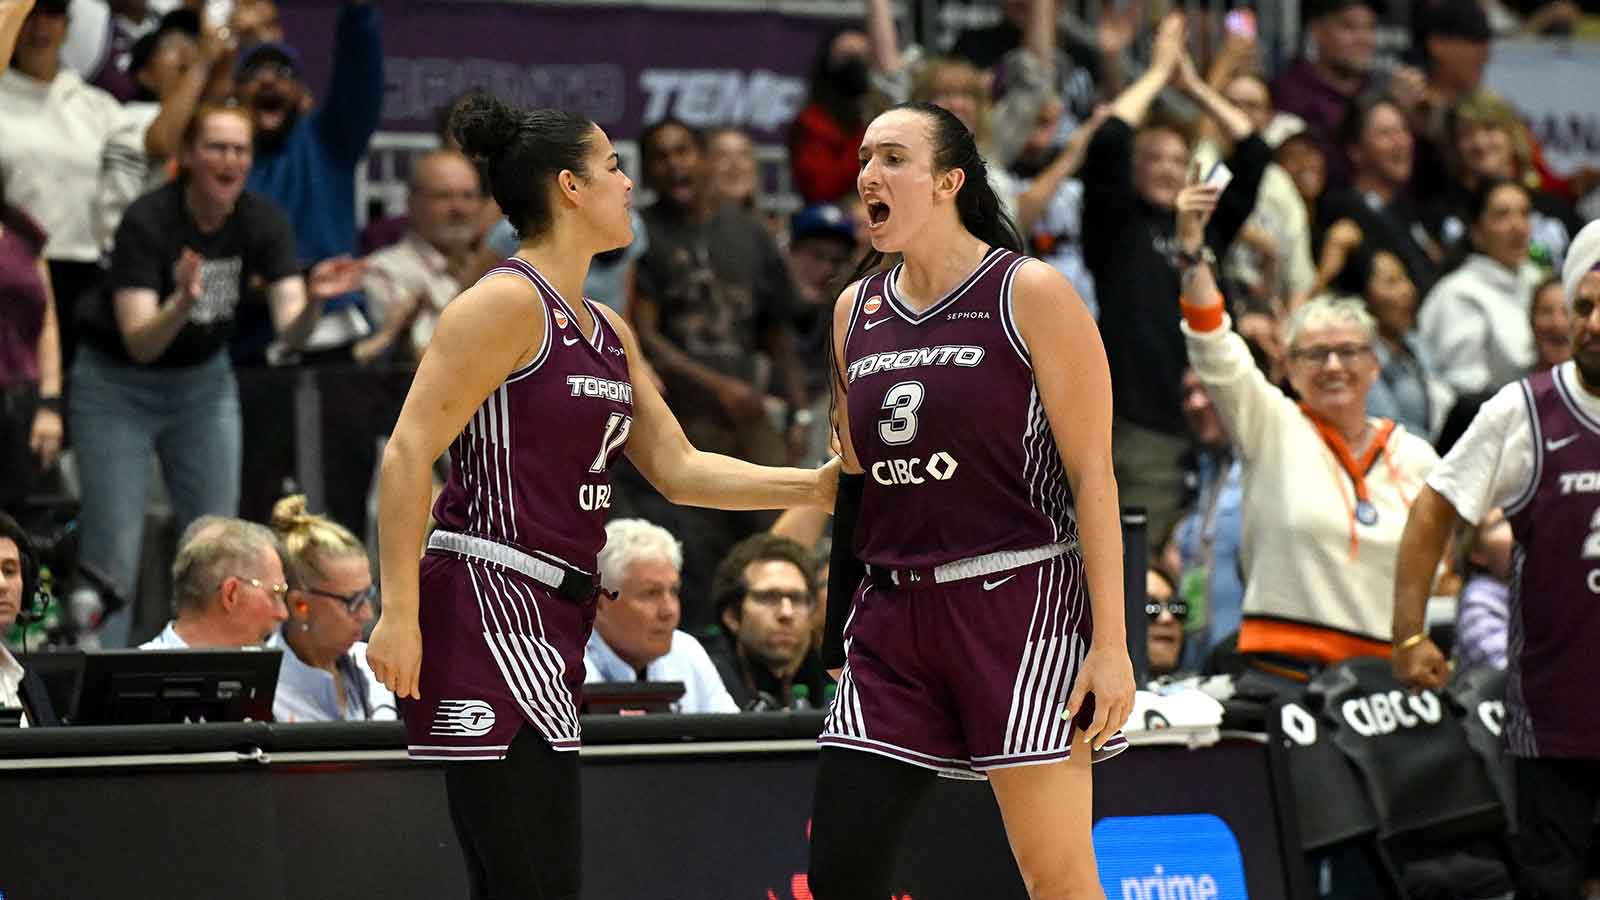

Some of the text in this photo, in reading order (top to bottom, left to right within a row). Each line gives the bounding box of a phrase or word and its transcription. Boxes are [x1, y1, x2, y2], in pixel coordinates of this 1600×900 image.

[640, 69, 807, 131] TEMP
[946, 311, 991, 321] SEPHORA
[848, 345, 985, 384] TORONTO
[878, 381, 925, 446] 3
[871, 457, 926, 486] CIBC
[1120, 863, 1217, 900] prime
